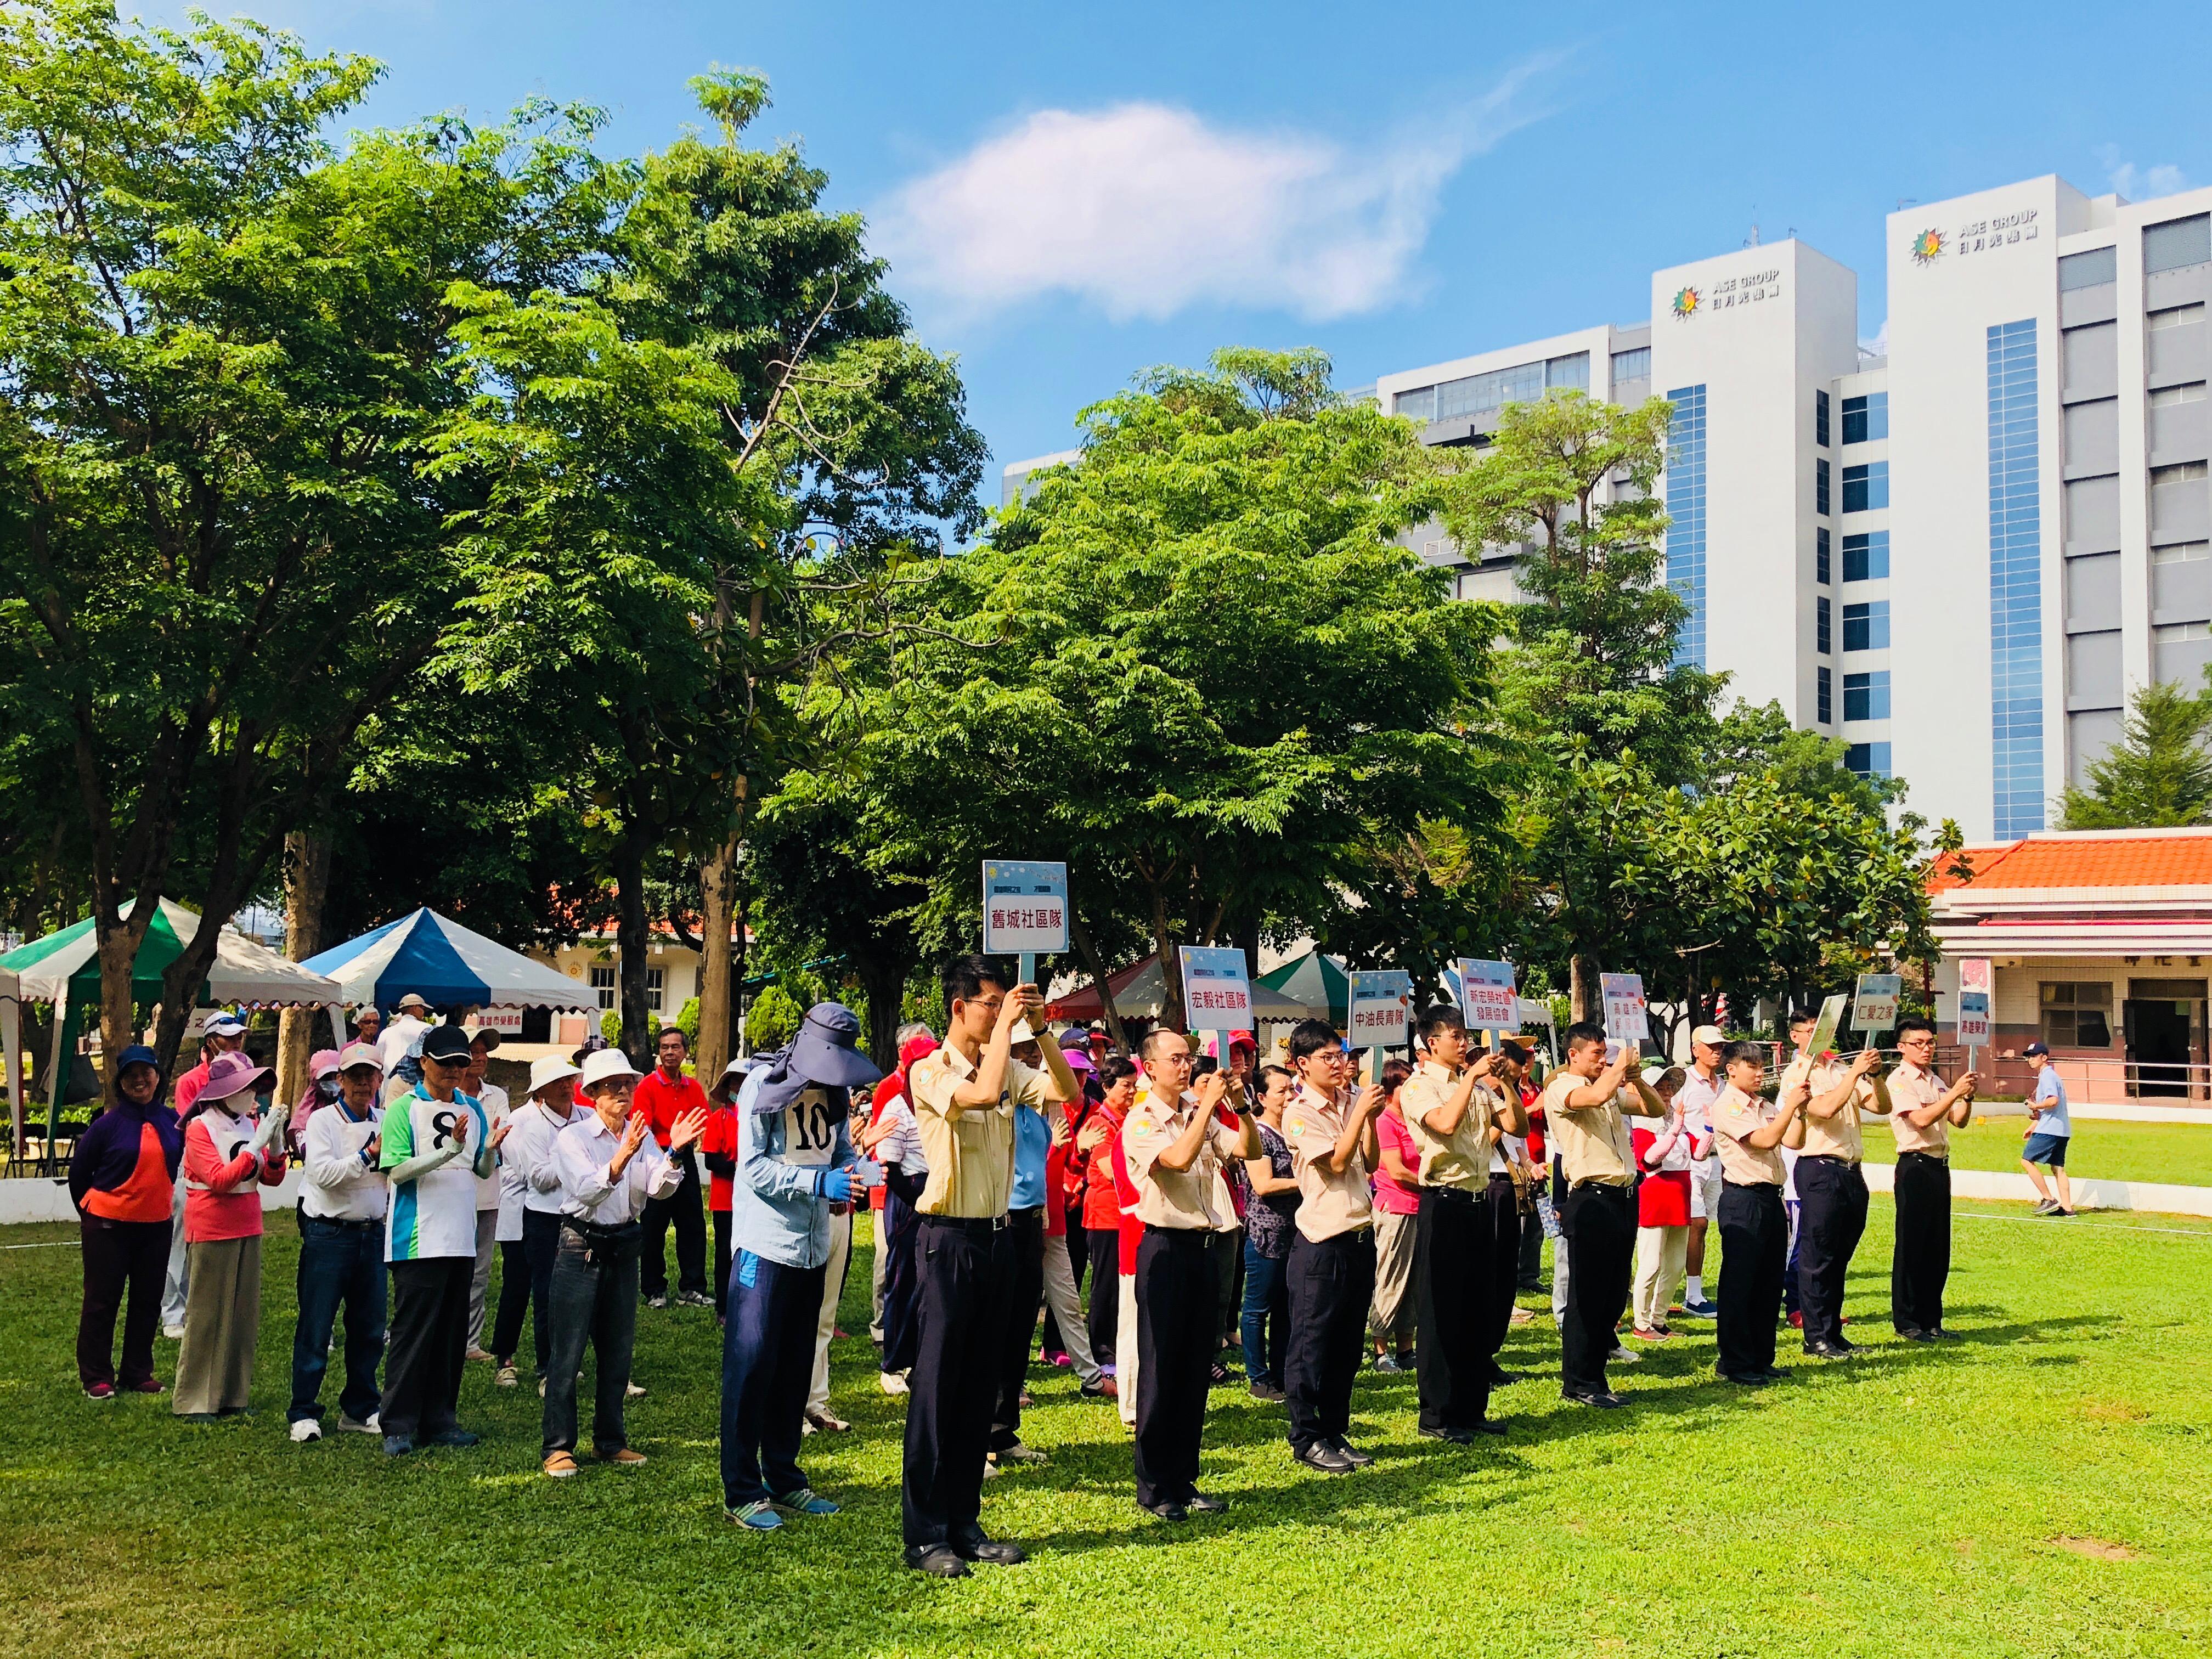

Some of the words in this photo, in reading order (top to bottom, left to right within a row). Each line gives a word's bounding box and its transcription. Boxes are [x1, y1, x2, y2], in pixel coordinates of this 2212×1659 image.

[1959, 221, 1987, 238] ASE
[1991, 208, 2038, 230] GROUP
[1713, 278, 1736, 295] ASE
[1740, 268, 1779, 289] GROUP
[992, 909, 1062, 929] 舊城社區隊
[1192, 991, 1247, 1009] 宏毅社區隊
[1470, 990, 1511, 1005] 新宏榮社區
[1476, 1006, 1509, 1021] 發展協會
[1614, 1002, 1638, 1015] 高雄市
[1858, 1005, 1894, 1020] 仁愛之家
[1355, 1009, 1404, 1028] 中油長青隊
[1962, 1020, 1987, 1035] 高雄榮家
[432, 1111, 458, 1150] 8
[792, 1102, 832, 1150] 10
